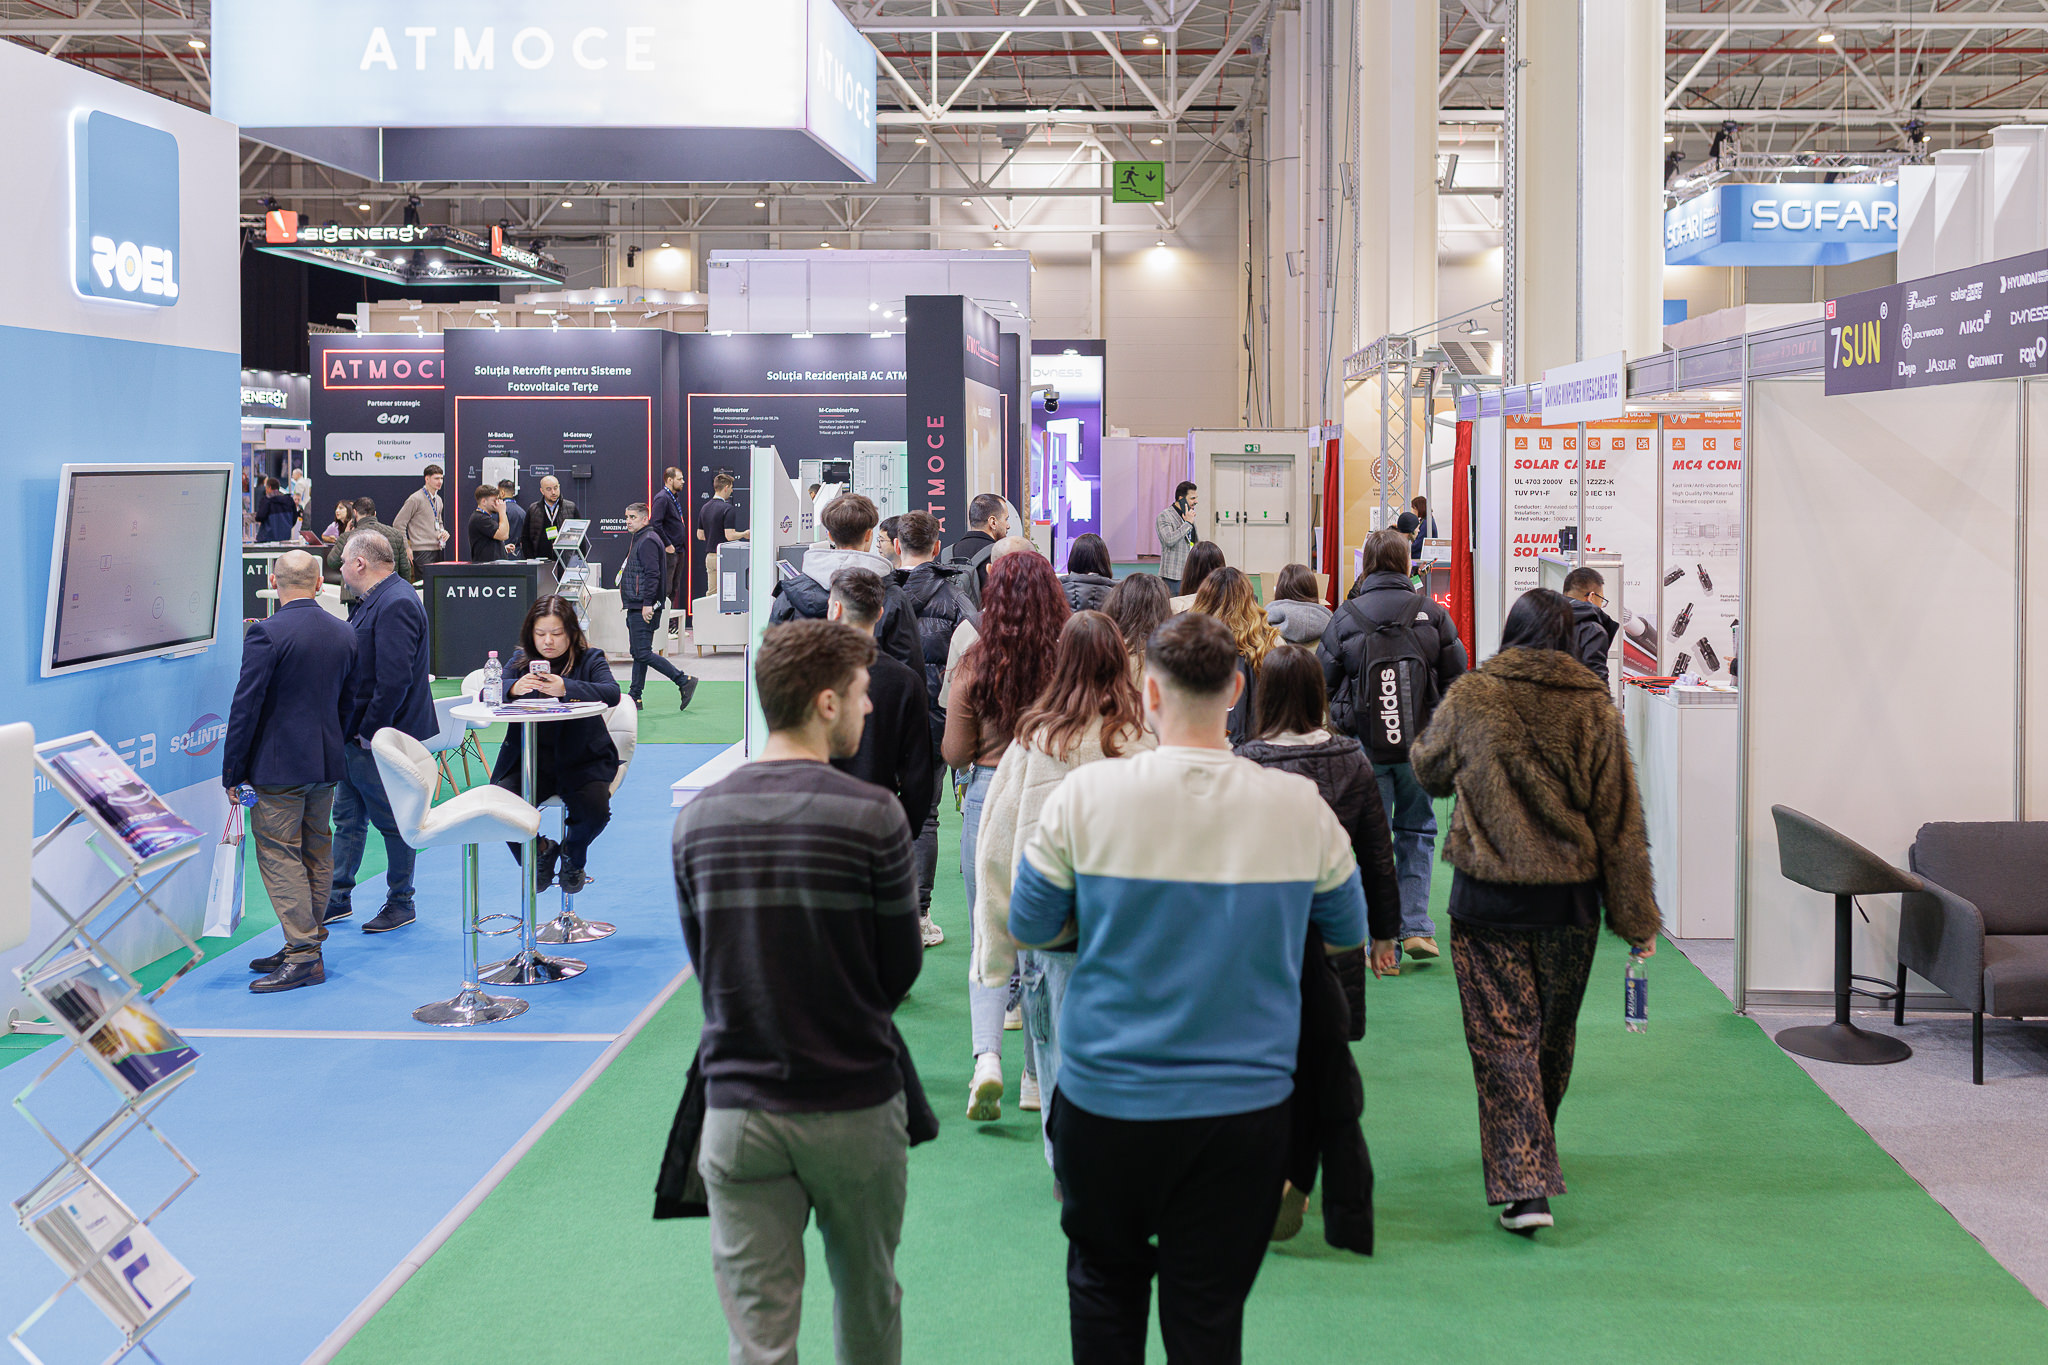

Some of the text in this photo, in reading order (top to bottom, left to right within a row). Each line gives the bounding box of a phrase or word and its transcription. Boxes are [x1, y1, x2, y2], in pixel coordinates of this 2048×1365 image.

[359, 26, 656, 71] ATMOCE
[817, 41, 870, 129] ATMOCE
[1751, 199, 1898, 231] SOFAR
[1666, 213, 1700, 250] SOFAR
[92, 235, 179, 298] ROEL
[2007, 271, 2038, 289] HYUNDAI
[2009, 305, 2048, 325] DYNESS
[1912, 328, 1944, 340] JOLYWOOD
[1830, 319, 1881, 369] 7SUN
[329, 359, 445, 379] ATMOC
[1967, 353, 2004, 369] GROWATT
[474, 365, 632, 377] Soluția Retrofit pentru Sisteme
[869, 371, 884, 381] AC
[1032, 368, 1083, 378] DYNESS
[1898, 361, 1917, 378] Deye
[507, 381, 570, 392] Fotovoltaice
[240, 386, 289, 409] ENERGY
[393, 399, 421, 408] strategic
[332, 450, 363, 462] enth
[1513, 459, 1560, 470] SOLAR
[1672, 459, 1742, 470] MC4 CON
[246, 564, 268, 575] AT
[446, 585, 518, 598] ATMOCE
[1378, 668, 1402, 745] adidas
